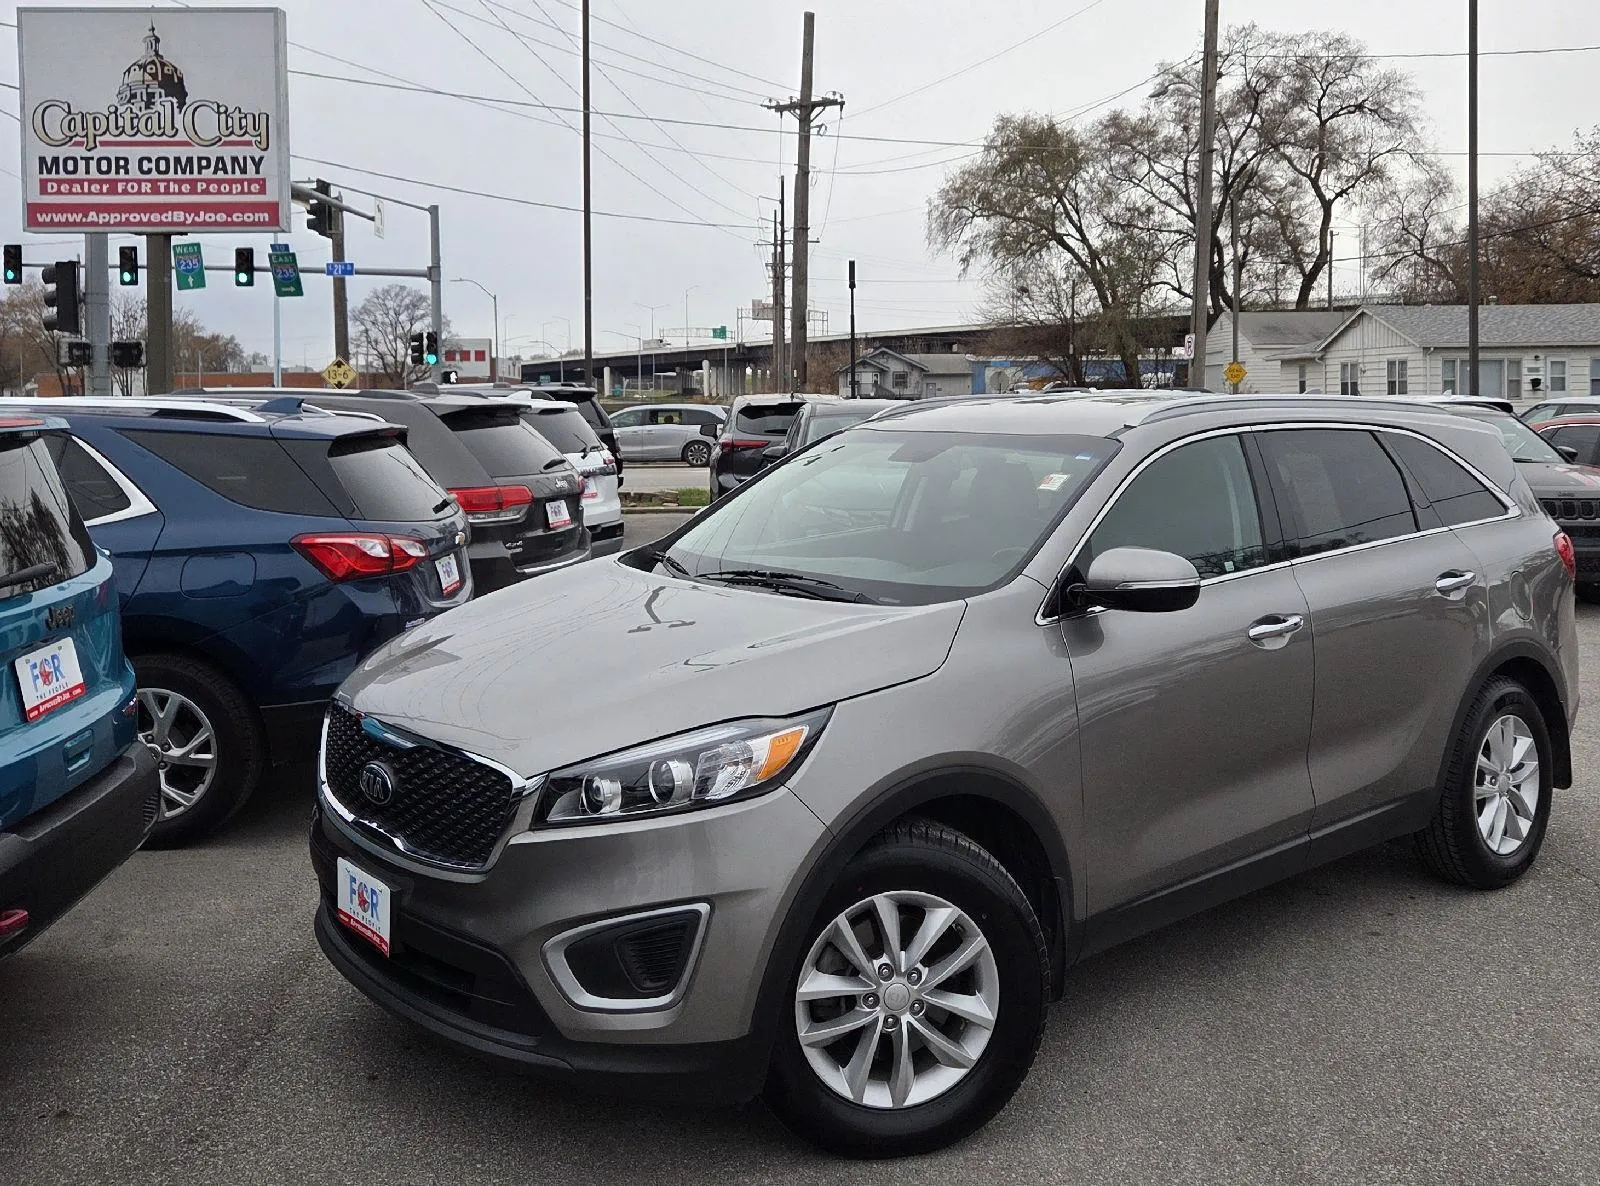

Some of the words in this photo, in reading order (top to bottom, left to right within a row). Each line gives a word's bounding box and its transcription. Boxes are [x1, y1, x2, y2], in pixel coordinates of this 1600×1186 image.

[32, 99, 178, 151] Capital
[183, 99, 269, 151] City
[38, 156, 130, 175] MOTOR
[137, 156, 265, 175] COMPANY
[47, 182, 110, 193] Dealer
[117, 182, 152, 193] FOR
[157, 182, 191, 193] The
[197, 182, 261, 195] People
[36, 211, 269, 225] www.ApprovedByJoe.com
[180, 259, 200, 270] 235
[276, 270, 295, 279] 235
[30, 653, 65, 693] FOR
[349, 874, 380, 921] FOR
